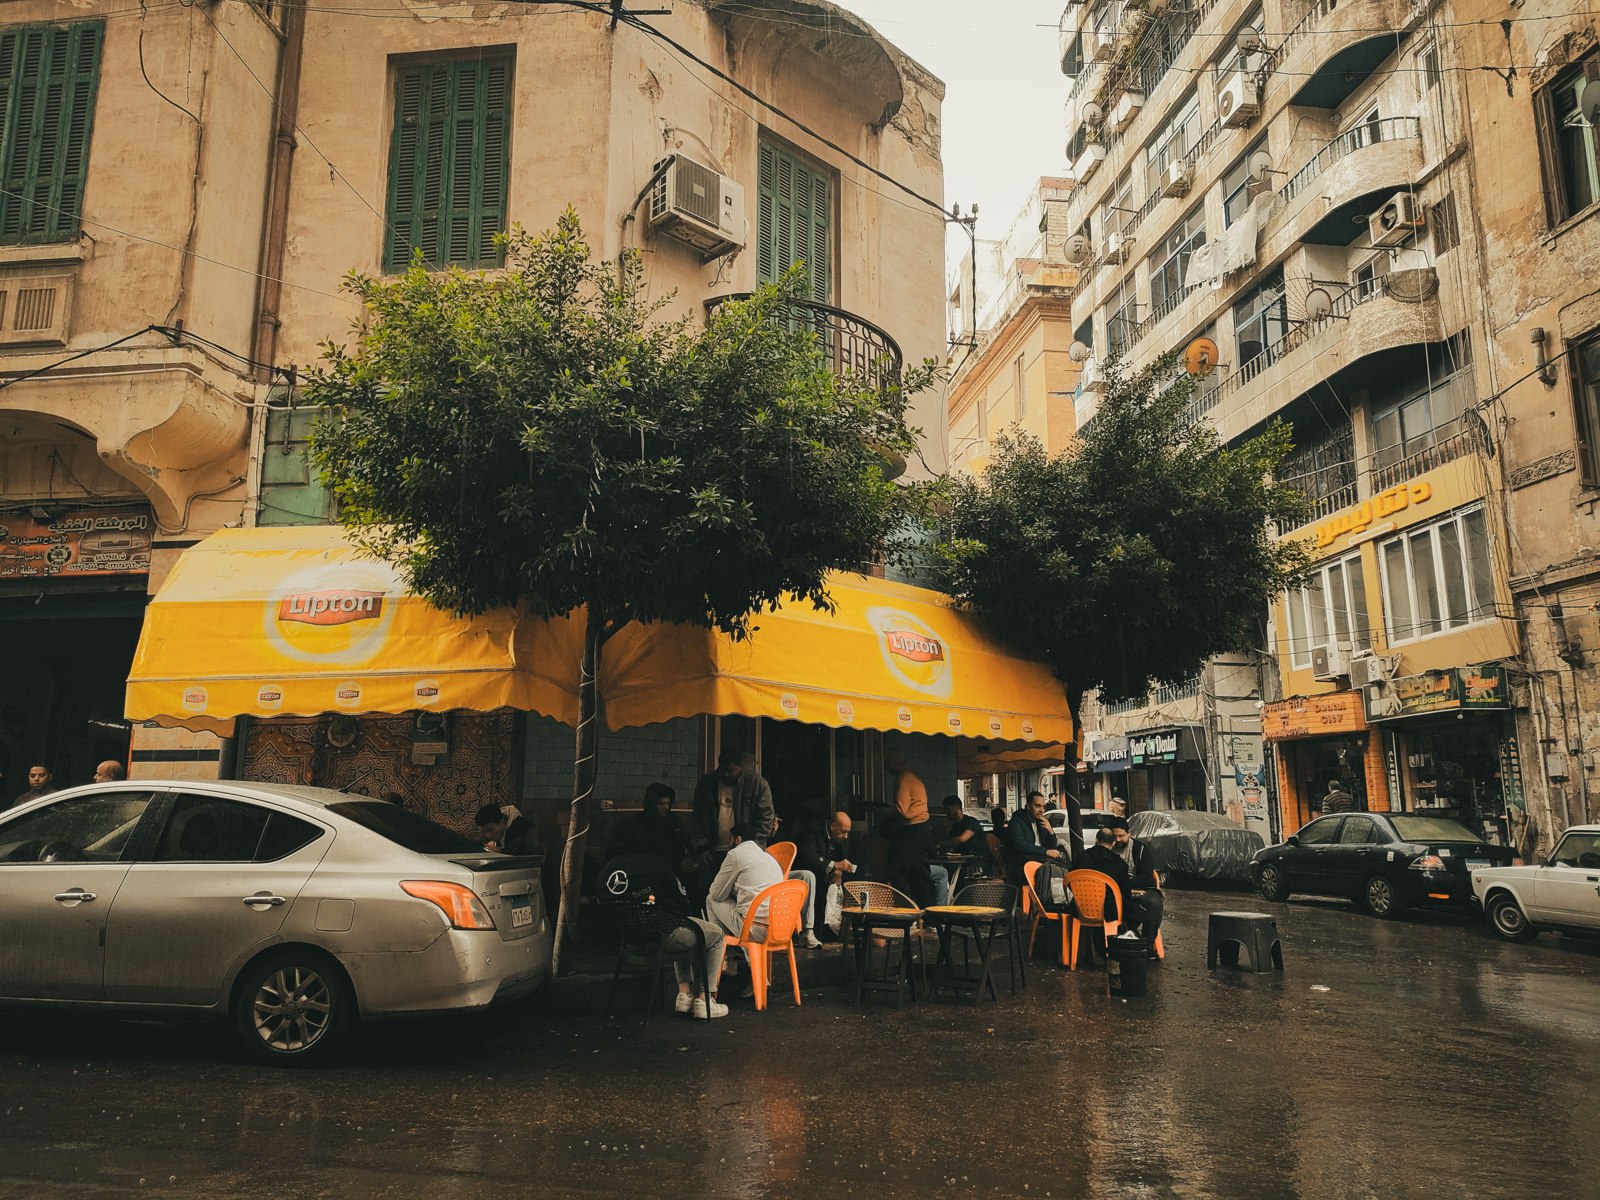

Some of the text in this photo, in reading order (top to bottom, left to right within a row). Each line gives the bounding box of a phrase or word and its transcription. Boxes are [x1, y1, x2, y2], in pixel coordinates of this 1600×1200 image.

[95, 515, 148, 531] الورشة
[289, 595, 374, 618] Lipton
[890, 633, 939, 655] Lipton
[1101, 750, 1110, 760] MY
[1110, 749, 1128, 760] DENT
[1129, 734, 1177, 756] Badr Dental
[632, 885, 653, 899] Benz
